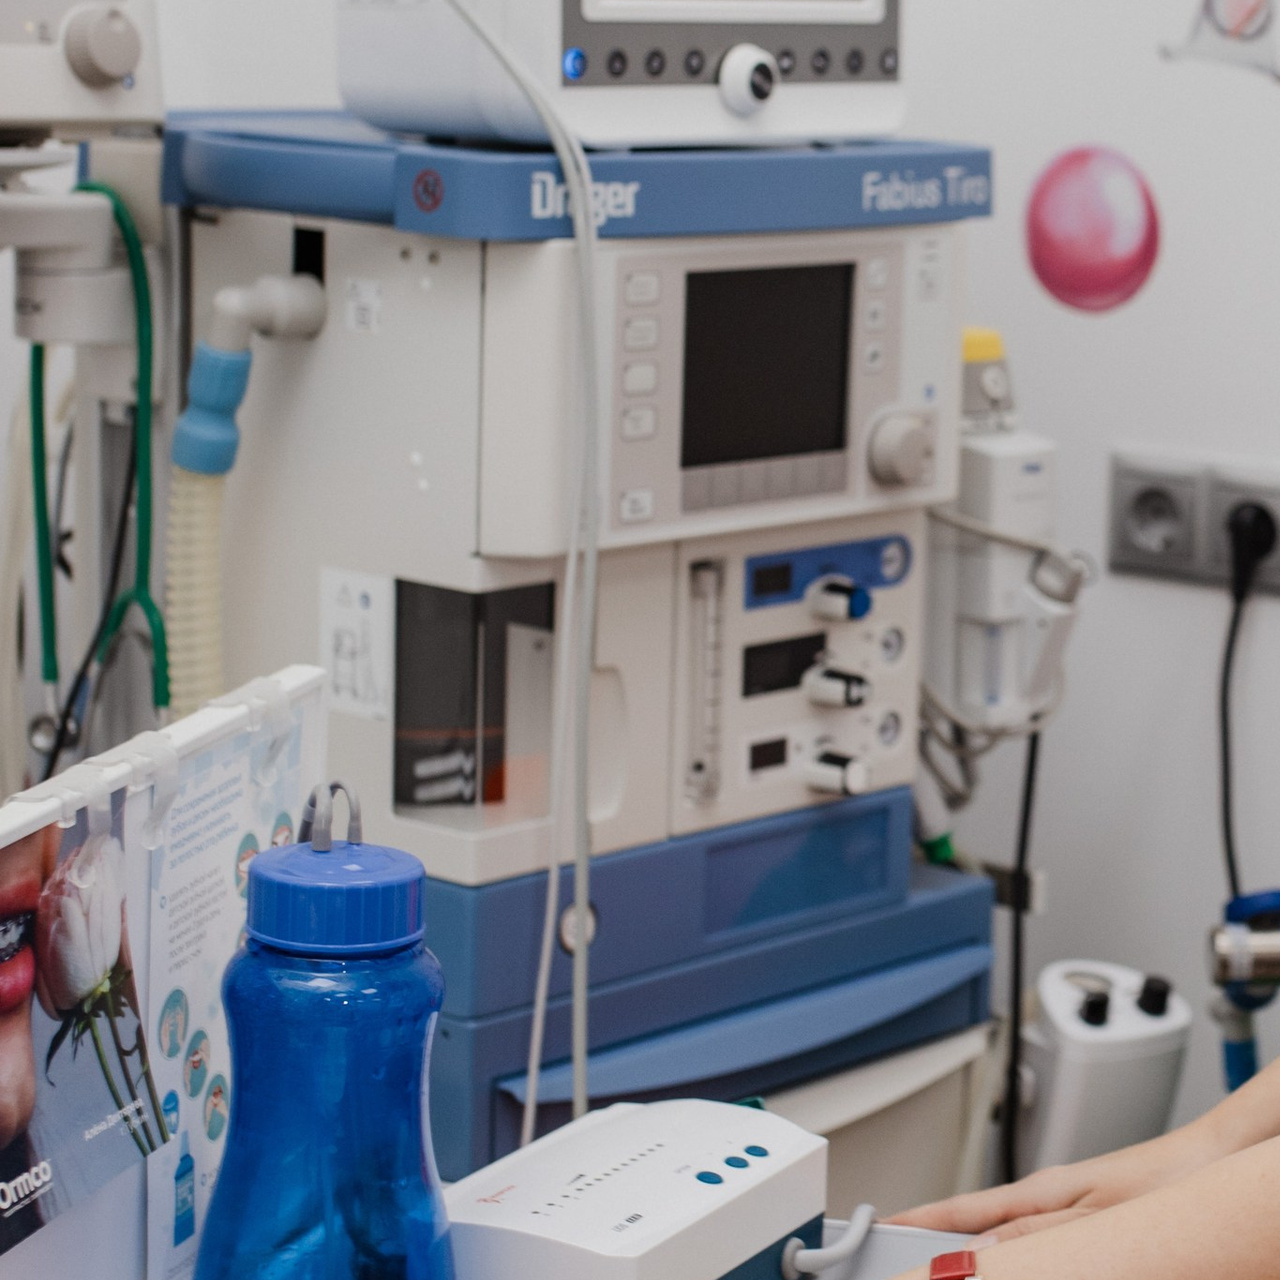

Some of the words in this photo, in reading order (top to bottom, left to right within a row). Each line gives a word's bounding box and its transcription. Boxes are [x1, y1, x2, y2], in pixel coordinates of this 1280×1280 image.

[531, 171, 640, 226] Drger
[862, 171, 942, 212] Fabius
[943, 166, 988, 206] Tiro
[0, 1161, 52, 1210] Ormco
